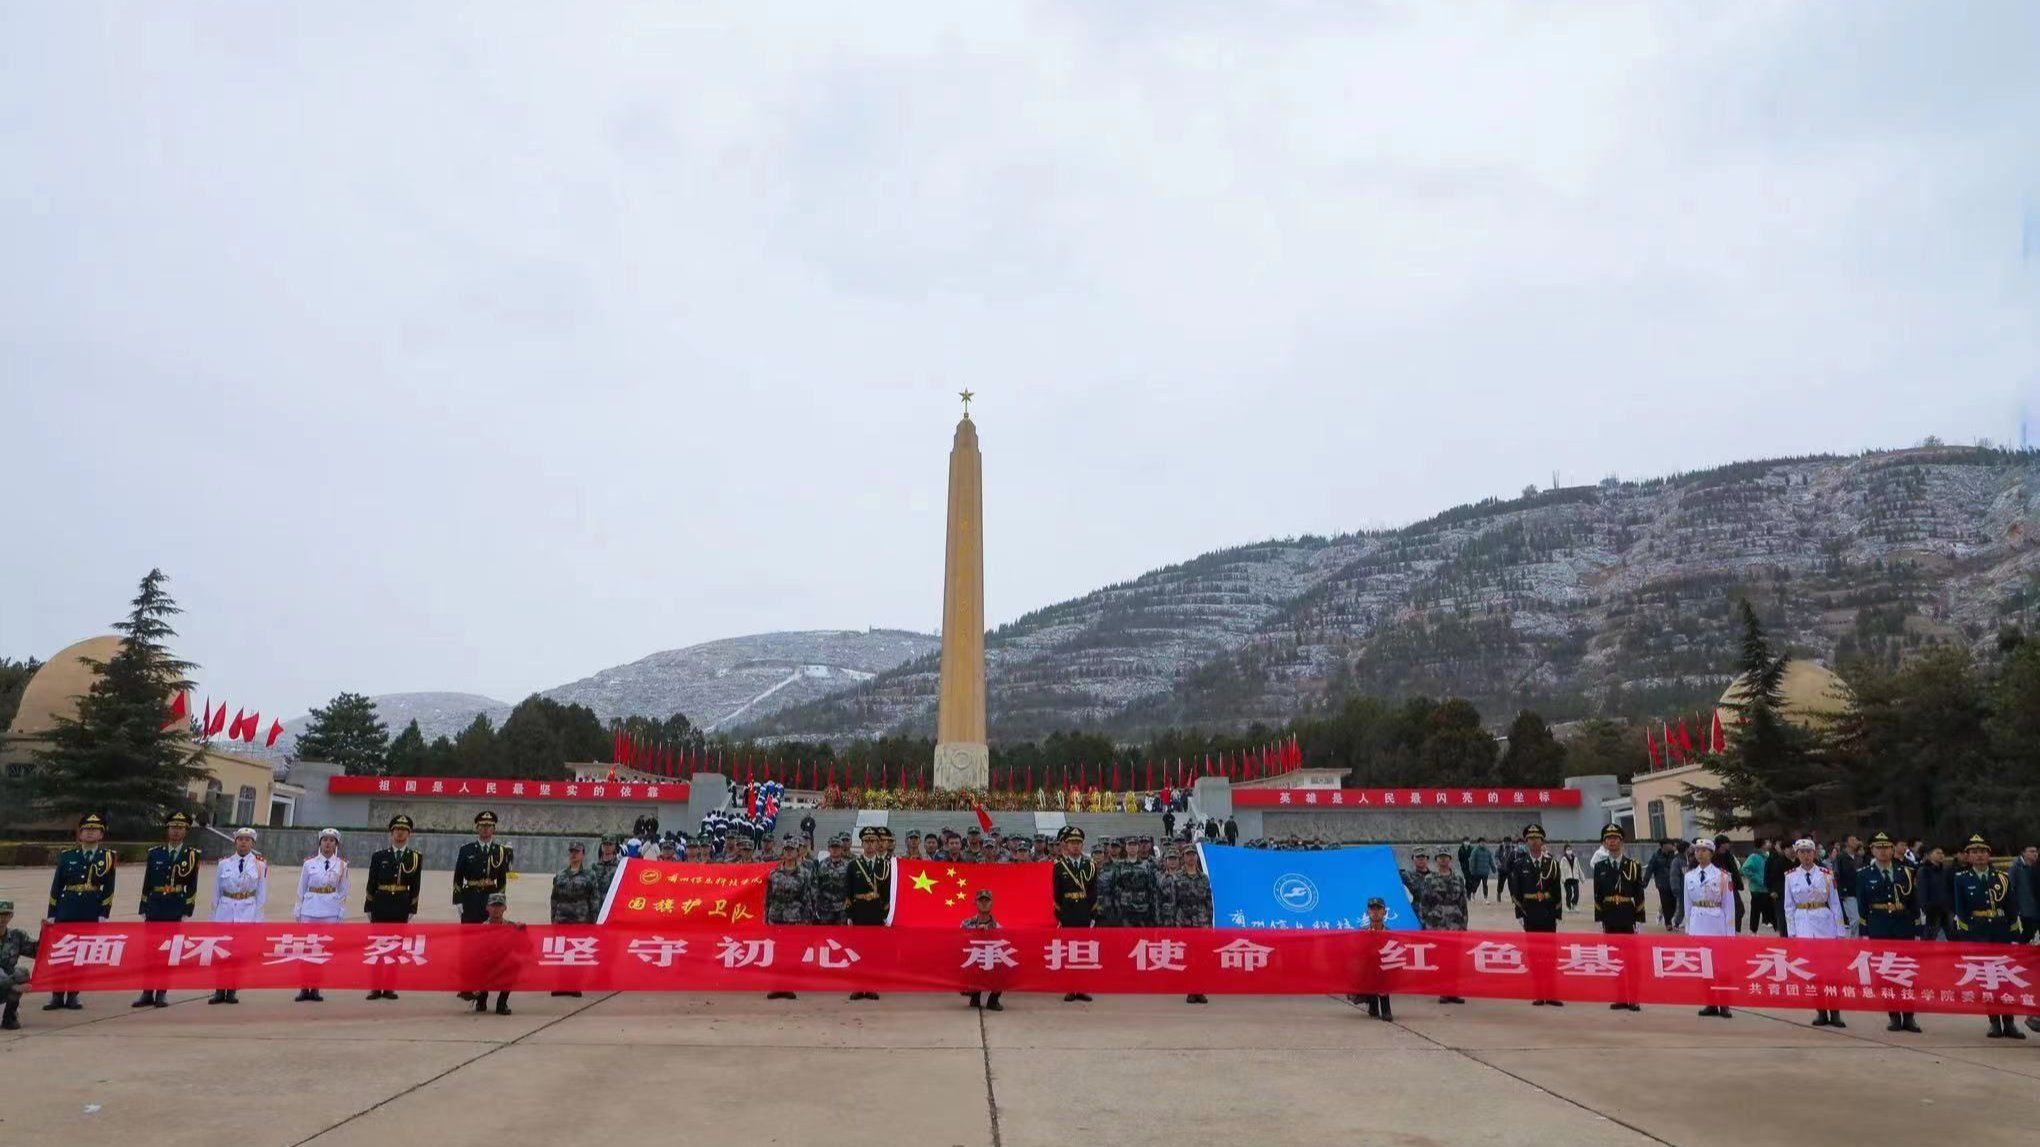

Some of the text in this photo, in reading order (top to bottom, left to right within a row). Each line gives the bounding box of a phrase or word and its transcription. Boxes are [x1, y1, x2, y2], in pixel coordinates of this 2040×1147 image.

[378, 780, 659, 798] 祖国是人民最坚实的依靠
[1279, 791, 1551, 805] 英雄是人民最闪亮的坐标
[48, 933, 2032, 991] 缅怀英烈 坚守初心 承担使命 红色基因永传承
